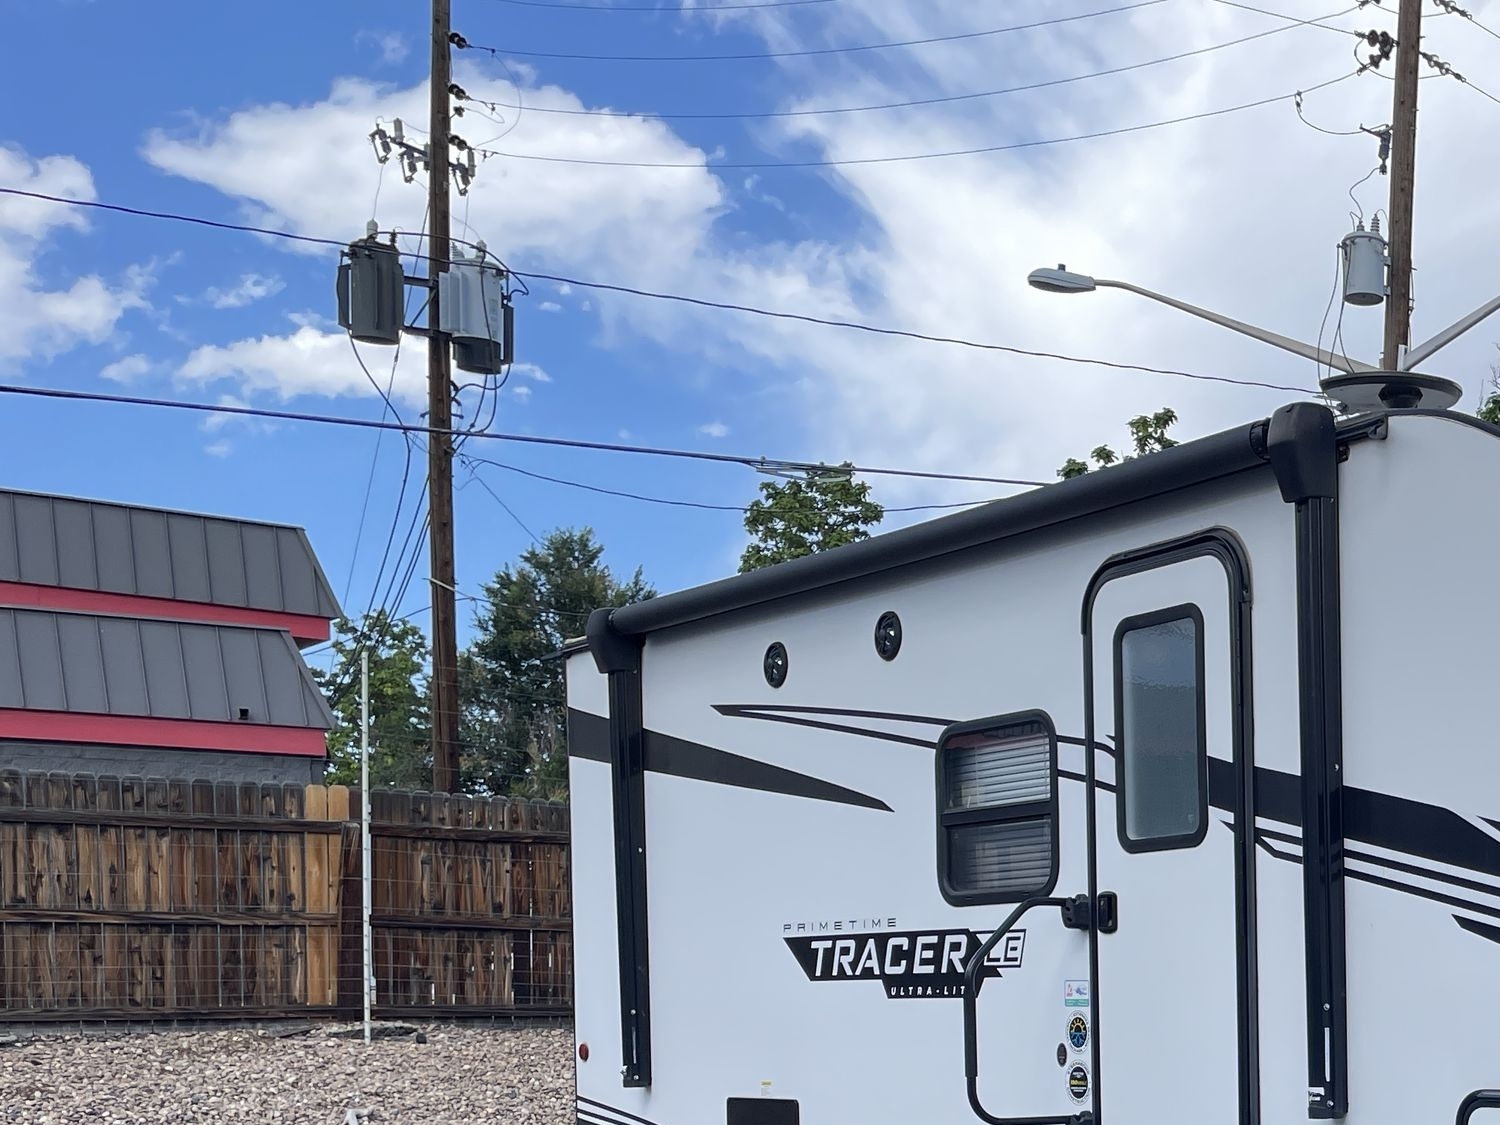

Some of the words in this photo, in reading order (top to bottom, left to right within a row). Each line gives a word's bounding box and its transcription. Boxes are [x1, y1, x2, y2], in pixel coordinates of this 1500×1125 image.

[783, 917, 897, 933] PRIMETIME
[811, 934, 968, 977] TRACER
[890, 985, 967, 996] ULTRA-LIT
